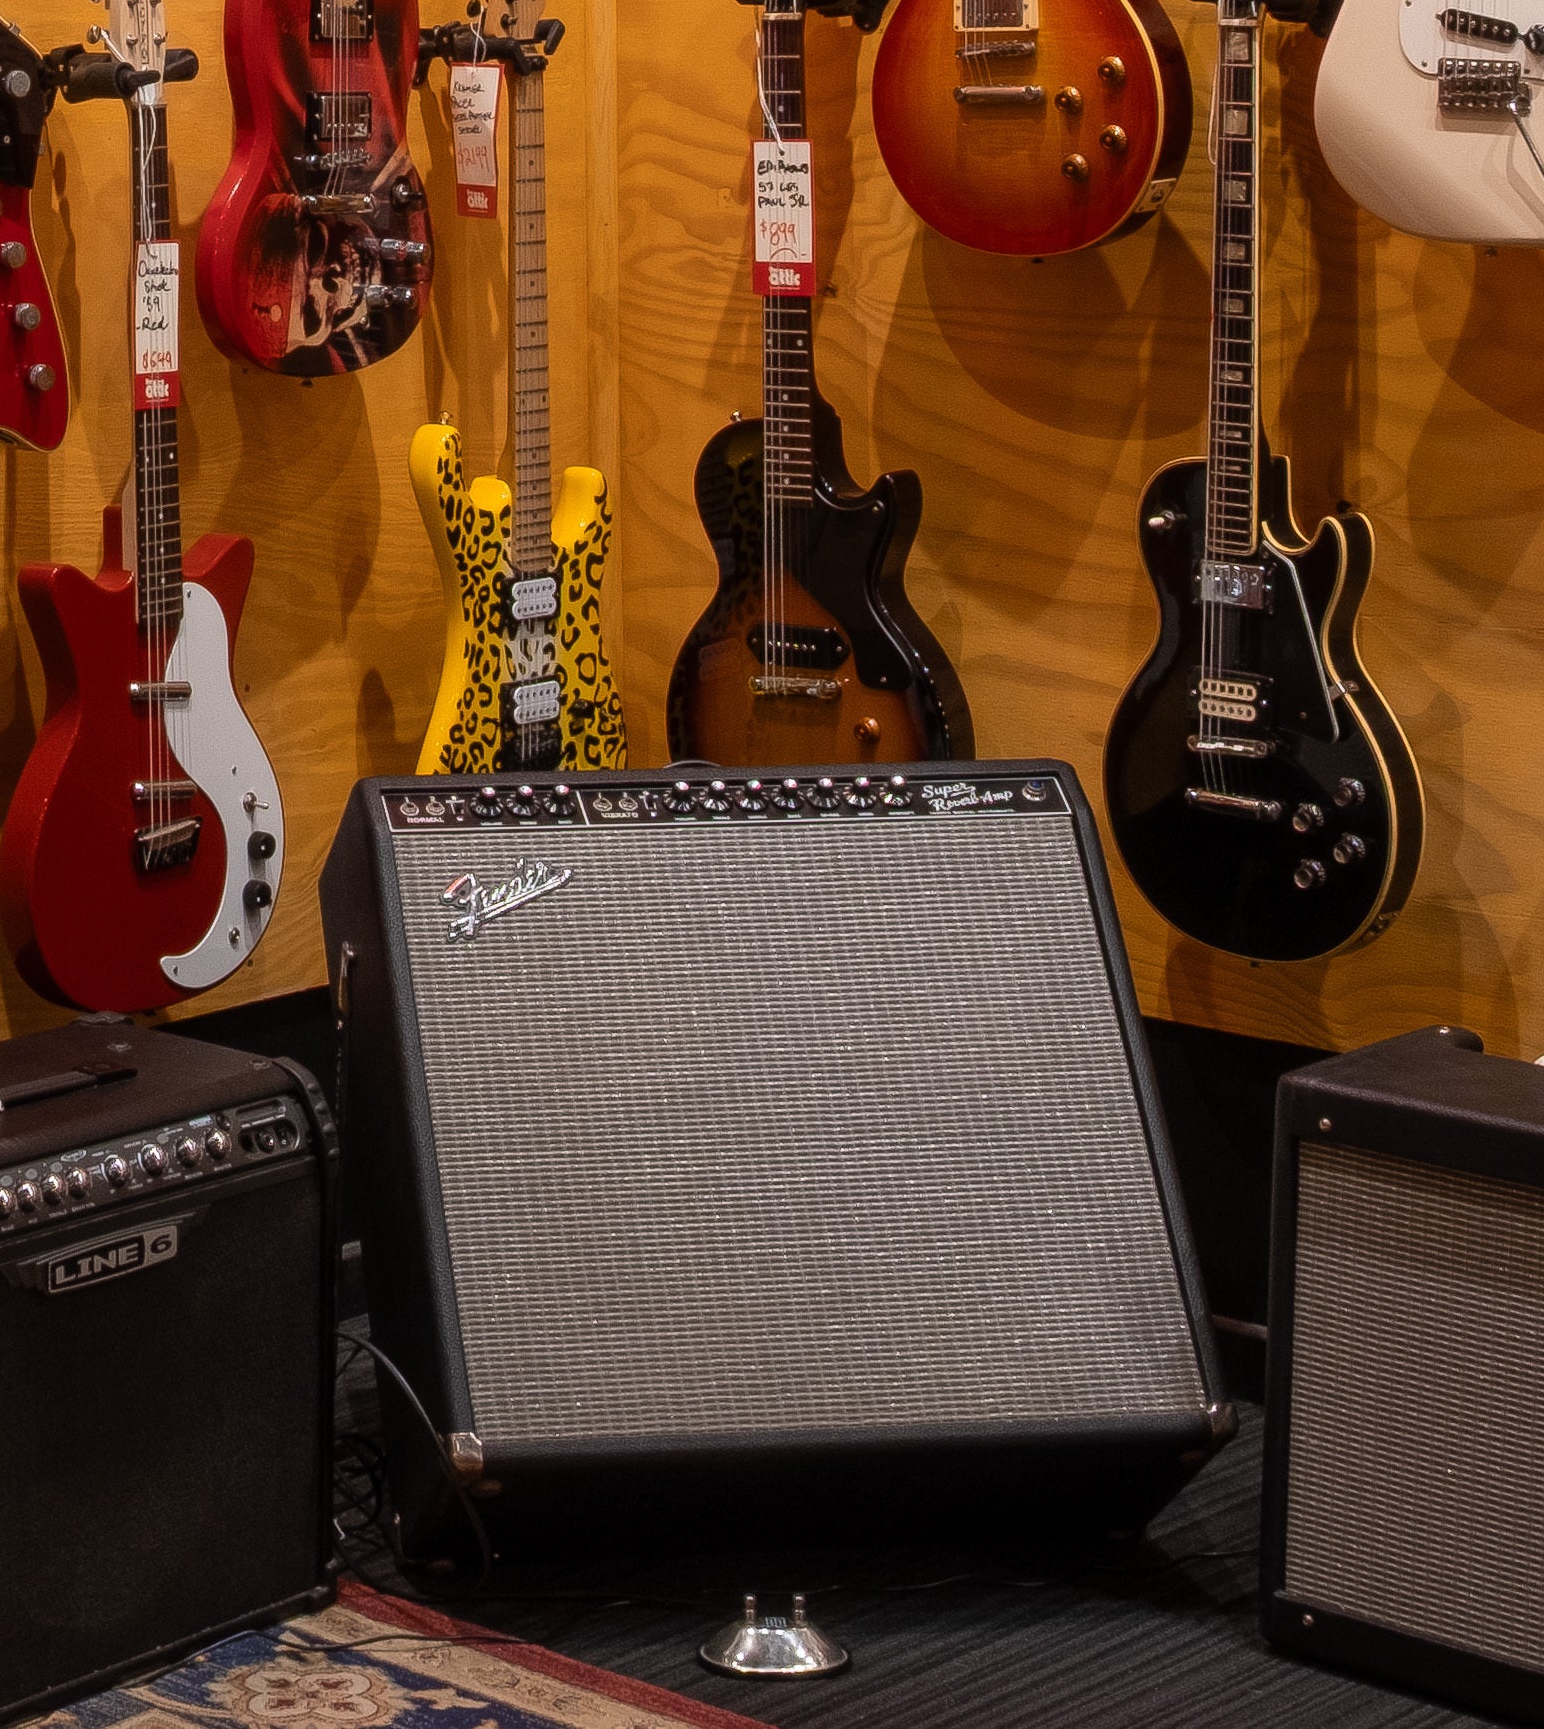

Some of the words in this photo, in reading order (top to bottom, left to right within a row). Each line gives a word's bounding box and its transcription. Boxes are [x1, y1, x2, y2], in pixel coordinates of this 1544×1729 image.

[759, 221, 799, 248] $899
[768, 267, 802, 287] attic
[921, 782, 977, 799] Super
[442, 856, 572, 943] Fender
[53, 1243, 140, 1286] LINE
[150, 1232, 174, 1263] 6
